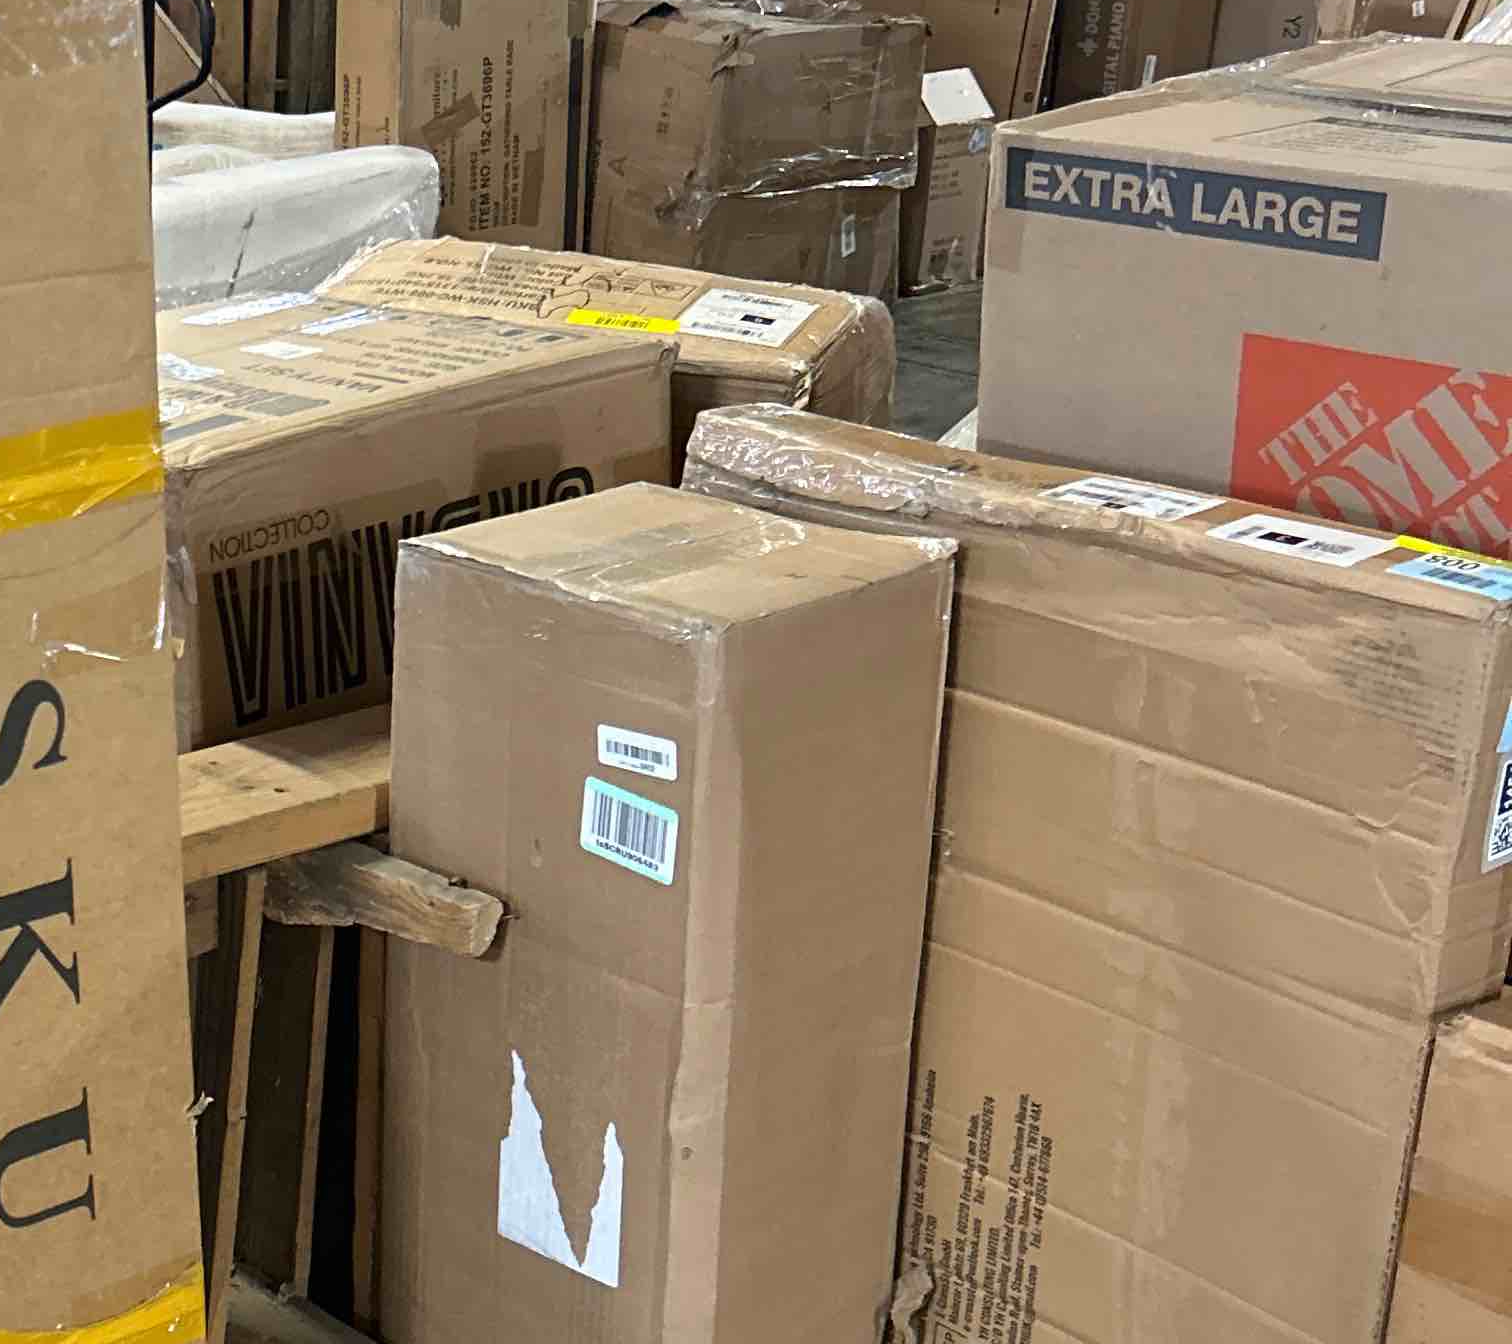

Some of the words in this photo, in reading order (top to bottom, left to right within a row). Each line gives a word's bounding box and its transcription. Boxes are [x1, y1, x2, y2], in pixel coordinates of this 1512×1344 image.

[478, 192, 490, 229] ITEM
[1024, 161, 1175, 218] EXTRA
[1191, 182, 1361, 244] LARGE
[1258, 381, 1379, 485] THE
[1296, 367, 1512, 530] OME
[209, 508, 330, 564] COLLECTION
